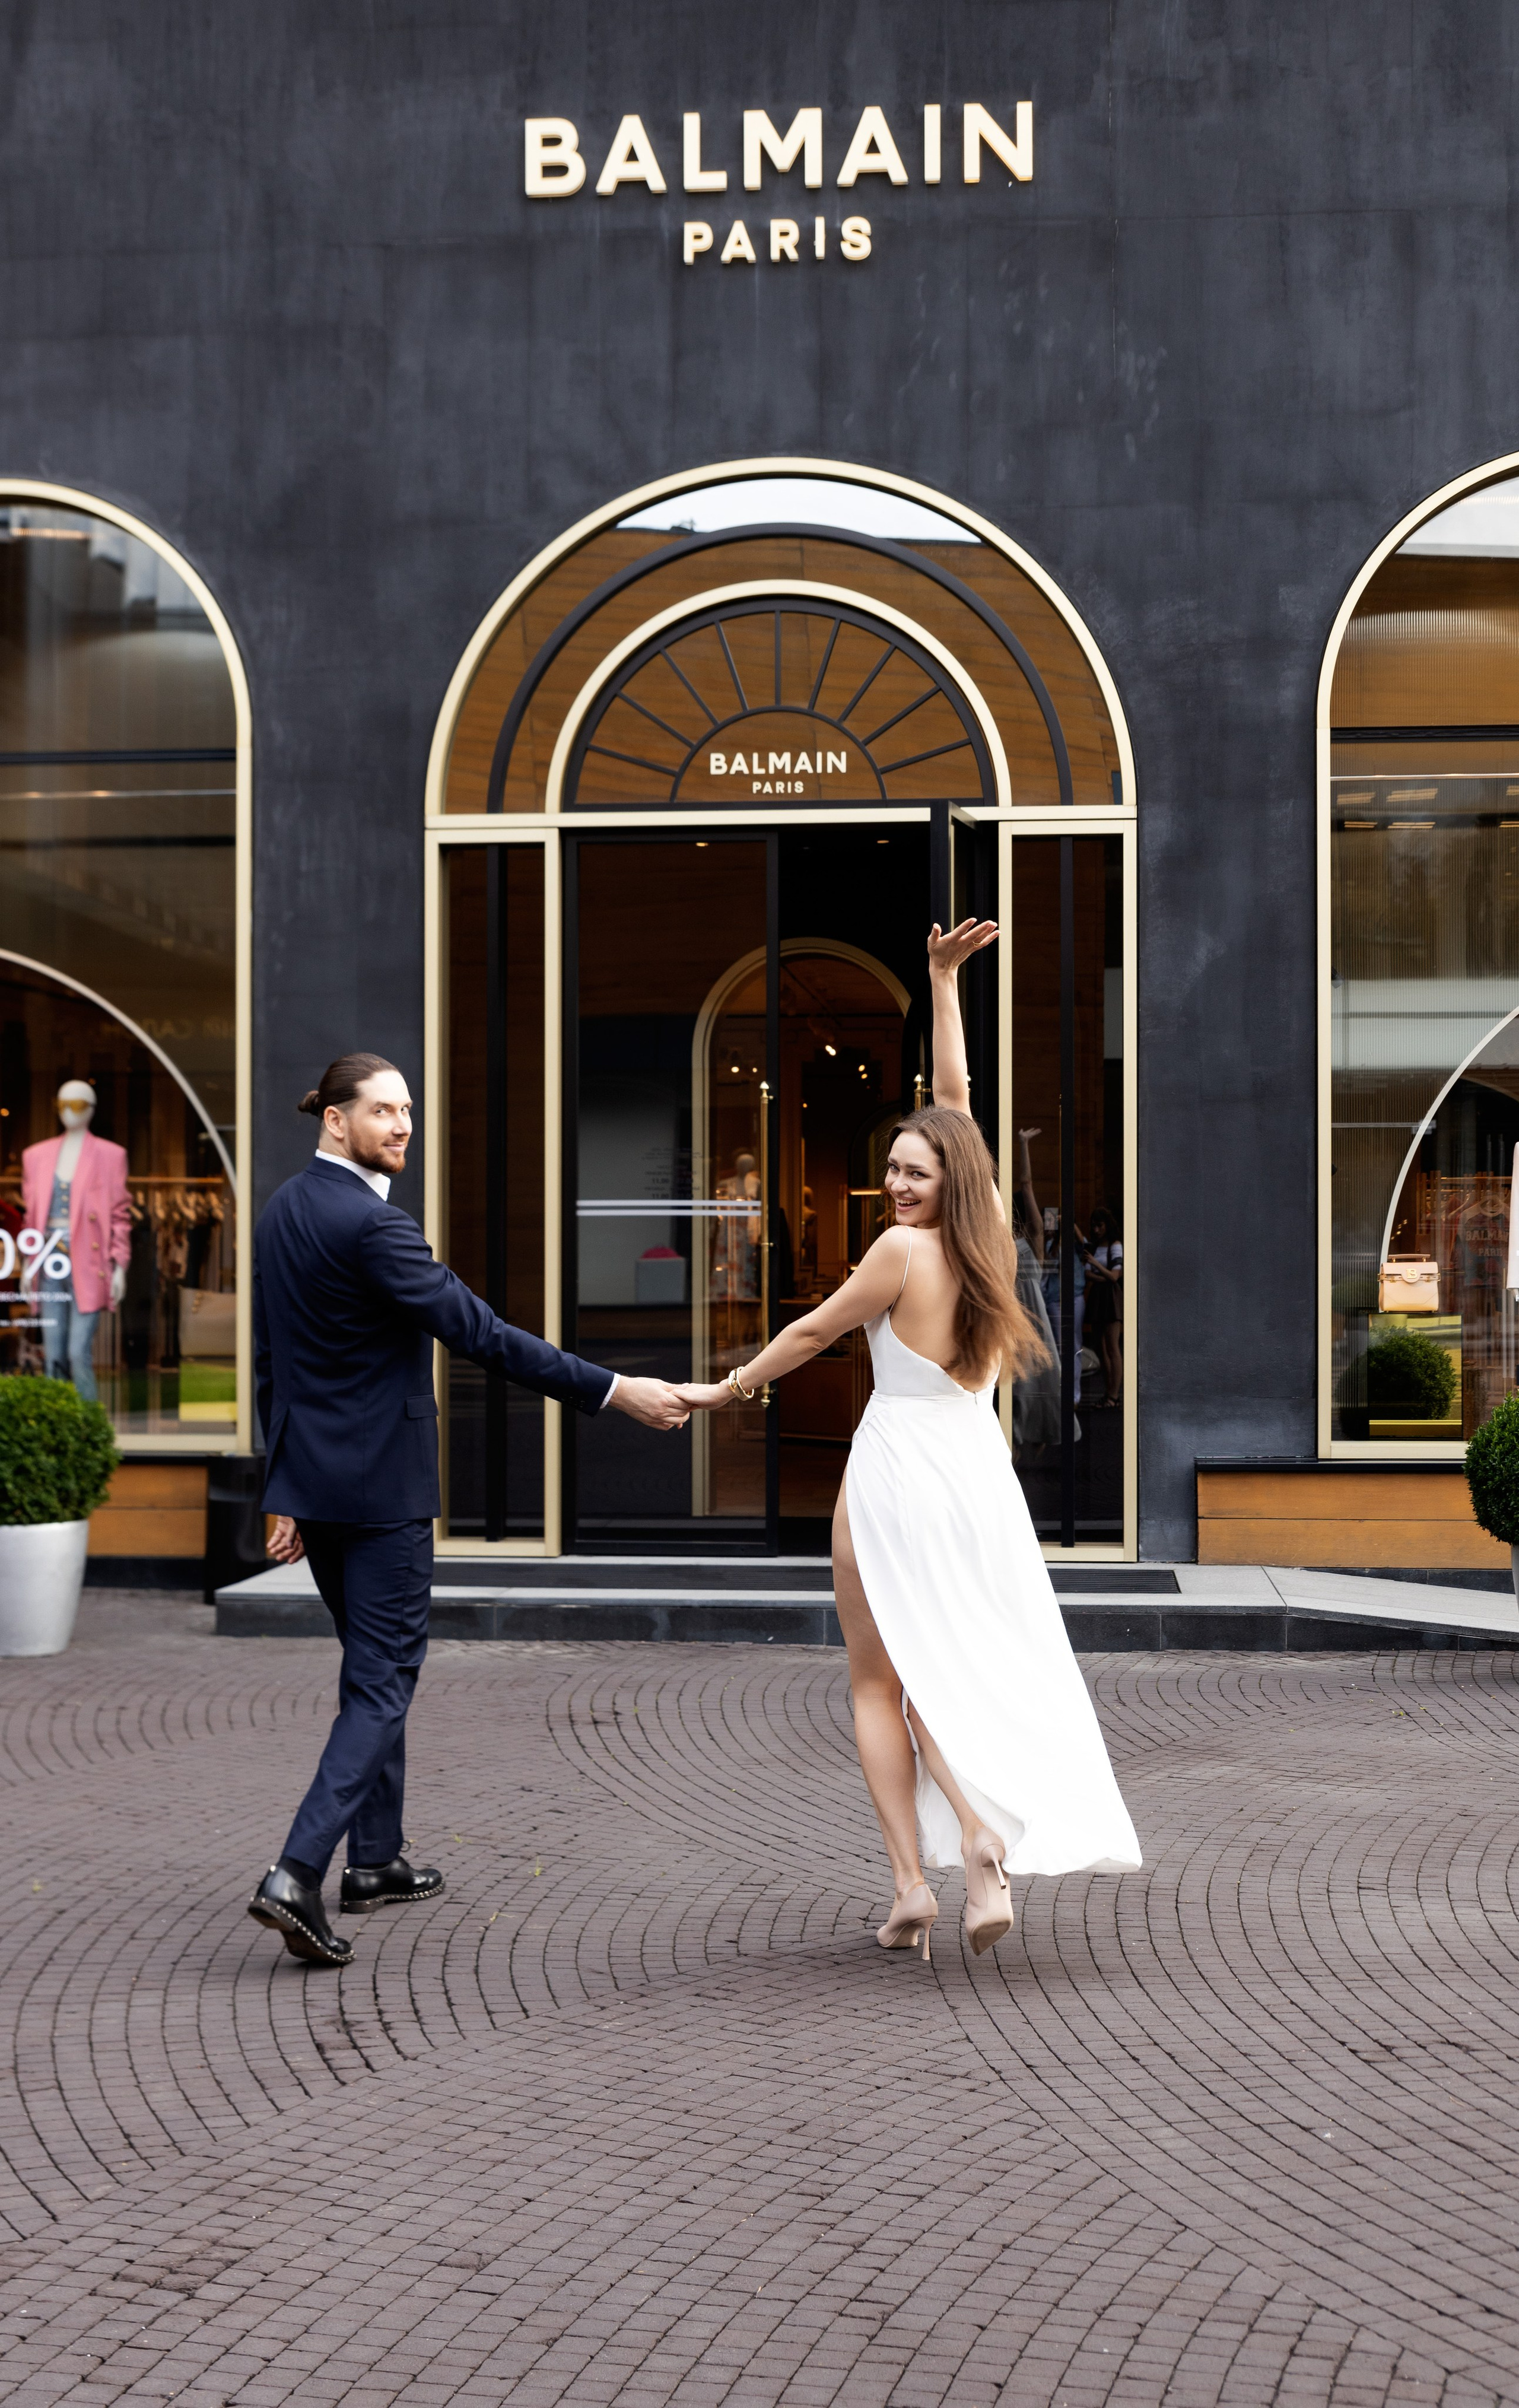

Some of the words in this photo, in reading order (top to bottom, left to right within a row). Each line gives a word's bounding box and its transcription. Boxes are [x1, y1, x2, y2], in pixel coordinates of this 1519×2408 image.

[525, 100, 1034, 198] BALMAIN
[683, 215, 872, 265] PARIS
[710, 751, 847, 775] BALMAIN
[752, 781, 804, 794] PARIS
